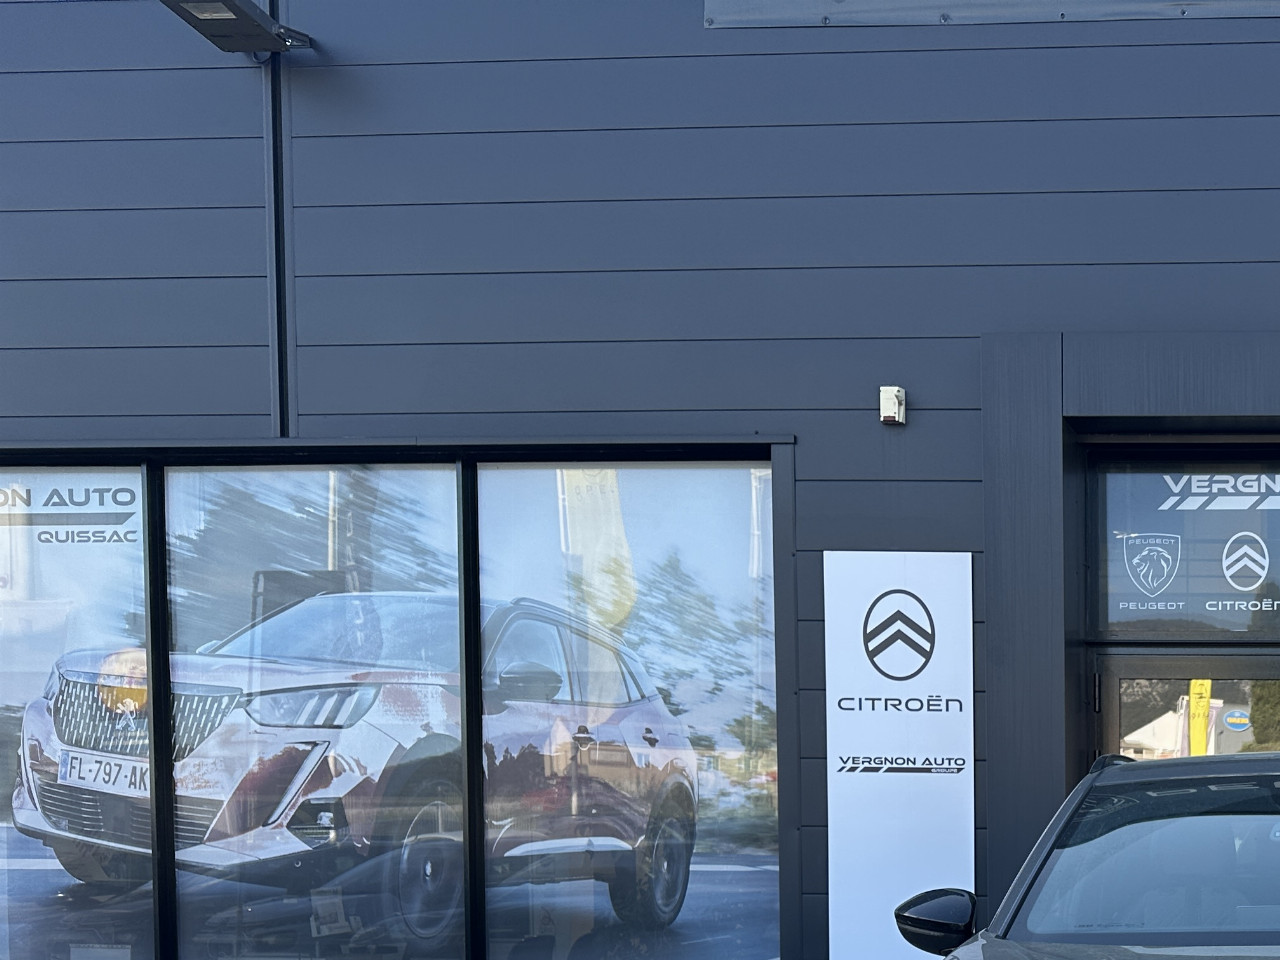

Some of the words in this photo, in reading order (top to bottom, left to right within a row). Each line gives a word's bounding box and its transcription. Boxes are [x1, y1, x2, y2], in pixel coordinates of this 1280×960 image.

[42, 487, 136, 507] AUTO
[37, 530, 138, 543] QUISSAC
[1119, 602, 1186, 610] PEUGEOT
[838, 756, 917, 767] VERGNON
[921, 757, 966, 767] AUTO
